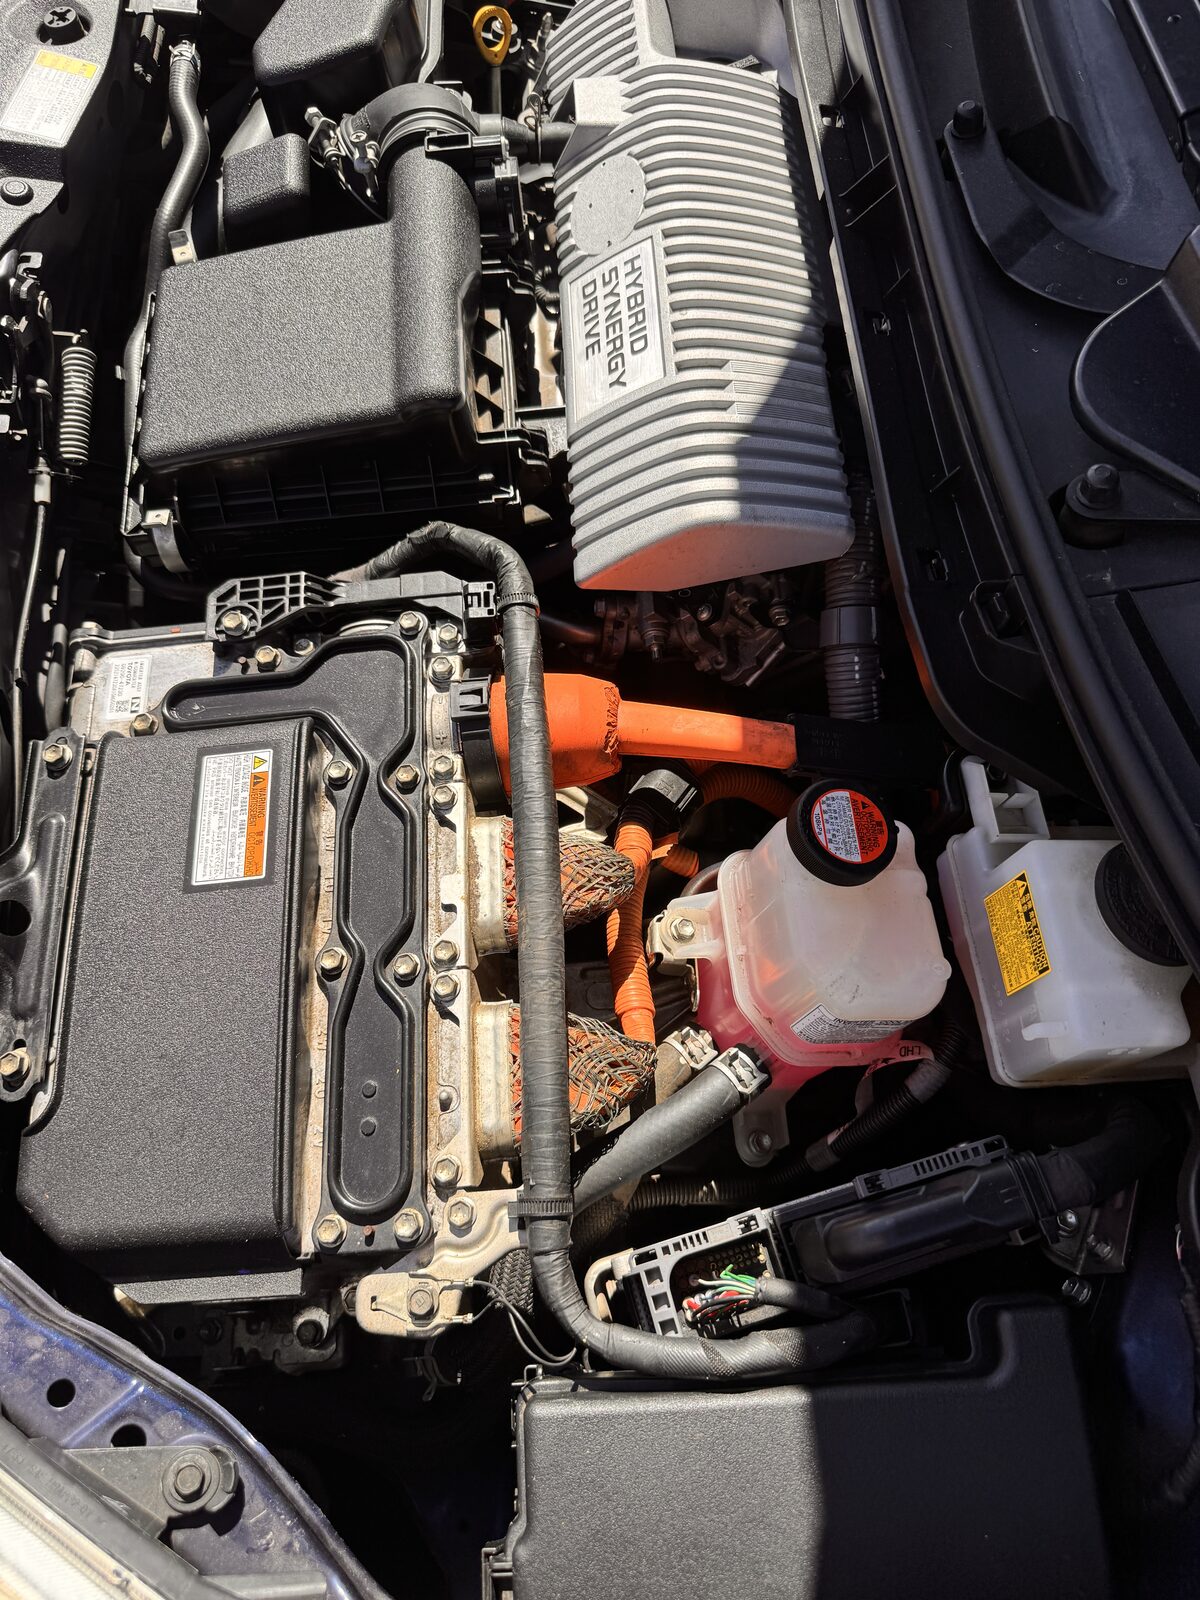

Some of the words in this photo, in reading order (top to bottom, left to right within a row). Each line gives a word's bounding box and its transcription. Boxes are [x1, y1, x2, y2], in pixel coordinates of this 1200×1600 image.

[582, 278, 601, 361] DRIVE
[623, 254, 649, 356] HYBRID
[602, 265, 627, 389] SYNERGY
[125, 662, 133, 685] TOYOTA
[248, 787, 259, 826] AVERTISSEMENT
[257, 786, 266, 818] WARNING
[813, 812, 823, 835] 108kPa
[851, 799, 868, 855] AVERTISSEMENT
[866, 811, 880, 848] WARNING
[1025, 919, 1043, 971] ATTENTION
[1032, 926, 1048, 968] CAUTION
[899, 1045, 921, 1058] LHD
